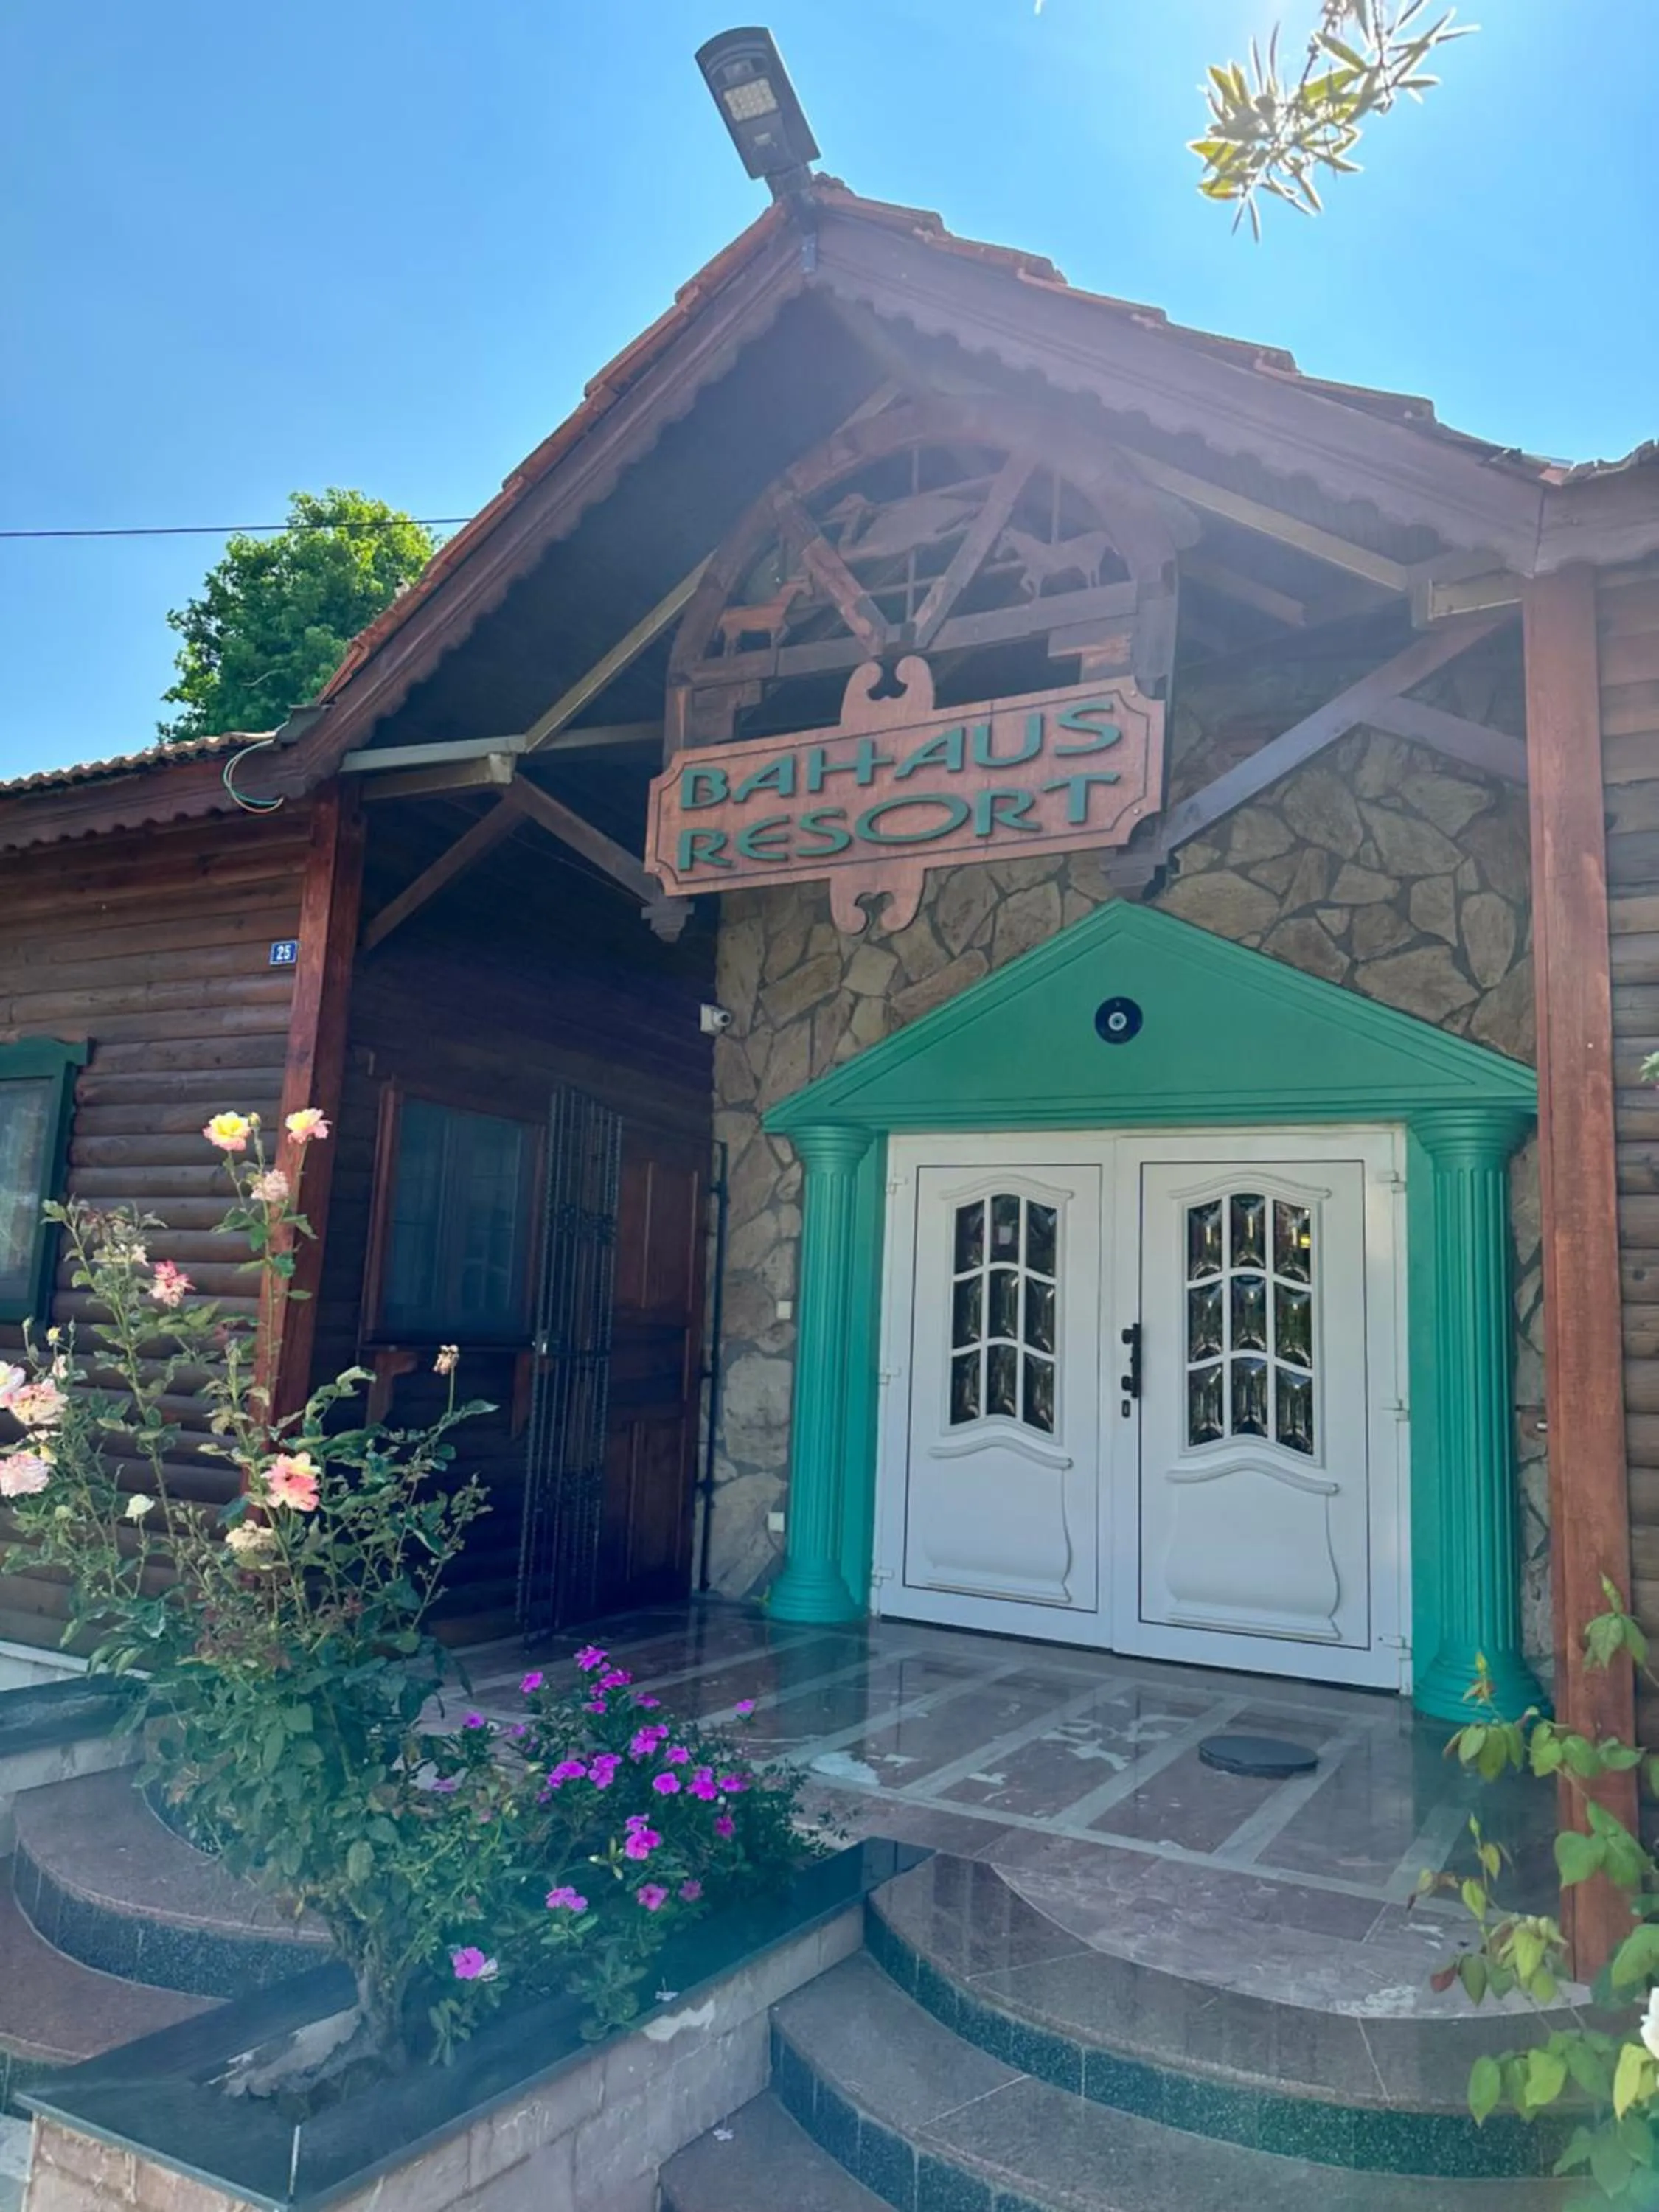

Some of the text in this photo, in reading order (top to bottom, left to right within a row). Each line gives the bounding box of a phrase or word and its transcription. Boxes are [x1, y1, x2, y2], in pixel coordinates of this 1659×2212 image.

[679, 702, 1122, 810] BAHAUS
[678, 772, 1121, 871] RESORT
[276, 945, 291, 960] 25
